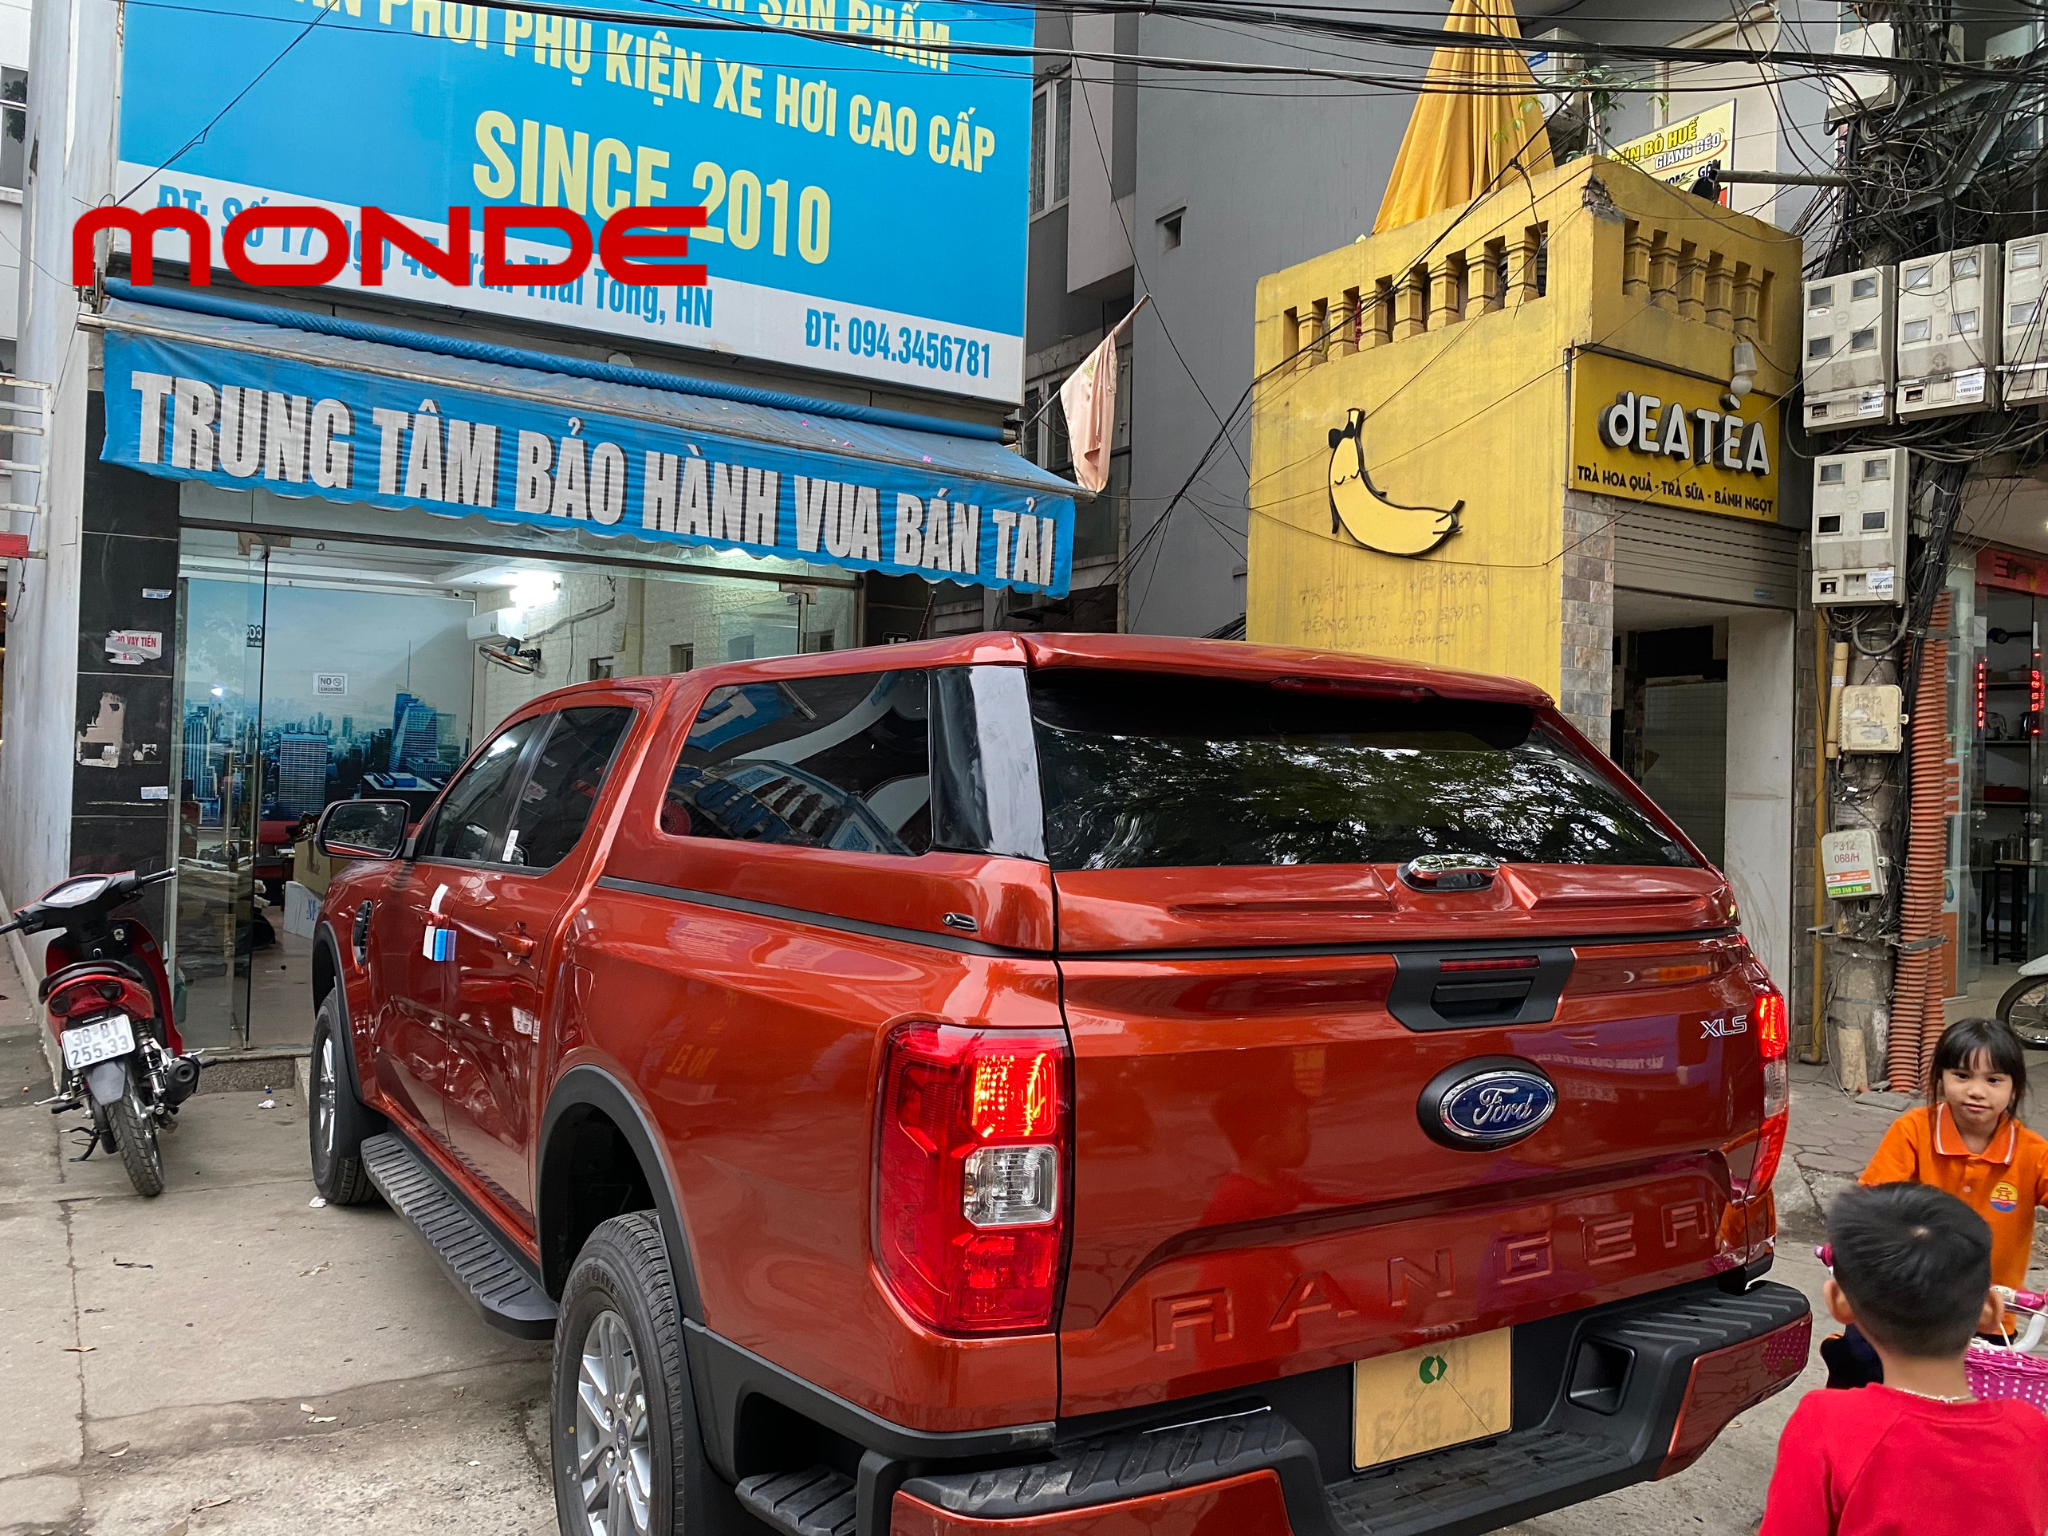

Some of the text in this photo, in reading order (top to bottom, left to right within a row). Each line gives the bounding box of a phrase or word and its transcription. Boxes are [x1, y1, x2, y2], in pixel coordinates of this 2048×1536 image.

[504, 10, 592, 87] PHỤ
[605, 29, 702, 107] KIỆN
[713, 57, 763, 119] XE
[775, 73, 837, 137] HƠI
[849, 94, 917, 156] CAO
[928, 107, 995, 173] CẤP
[1655, 144, 1693, 170] GIANG
[472, 111, 831, 264] SINCE 2010
[675, 282, 713, 328] HN
[804, 308, 991, 379] ĐT: 094.3456781
[131, 371, 1055, 587] TRUNG TÂM BẢO HÀNH VUA BÁN TẢI
[1577, 462, 1599, 483] TRÀ
[1602, 470, 1626, 488] HOA
[1629, 472, 1652, 492] QUẢ
[1661, 478, 1682, 498] TRÀ
[1685, 482, 1704, 501] SỮA
[1714, 487, 1742, 508] BÁNH
[1744, 497, 1773, 516] NGỌT
[320, 677, 332, 685] NO
[71, 1035, 129, 1065] 255.33
[1700, 1015, 1747, 1039] XLS
[1472, 1086, 1534, 1125] Ford
[1153, 1203, 1711, 1352] RANGER
